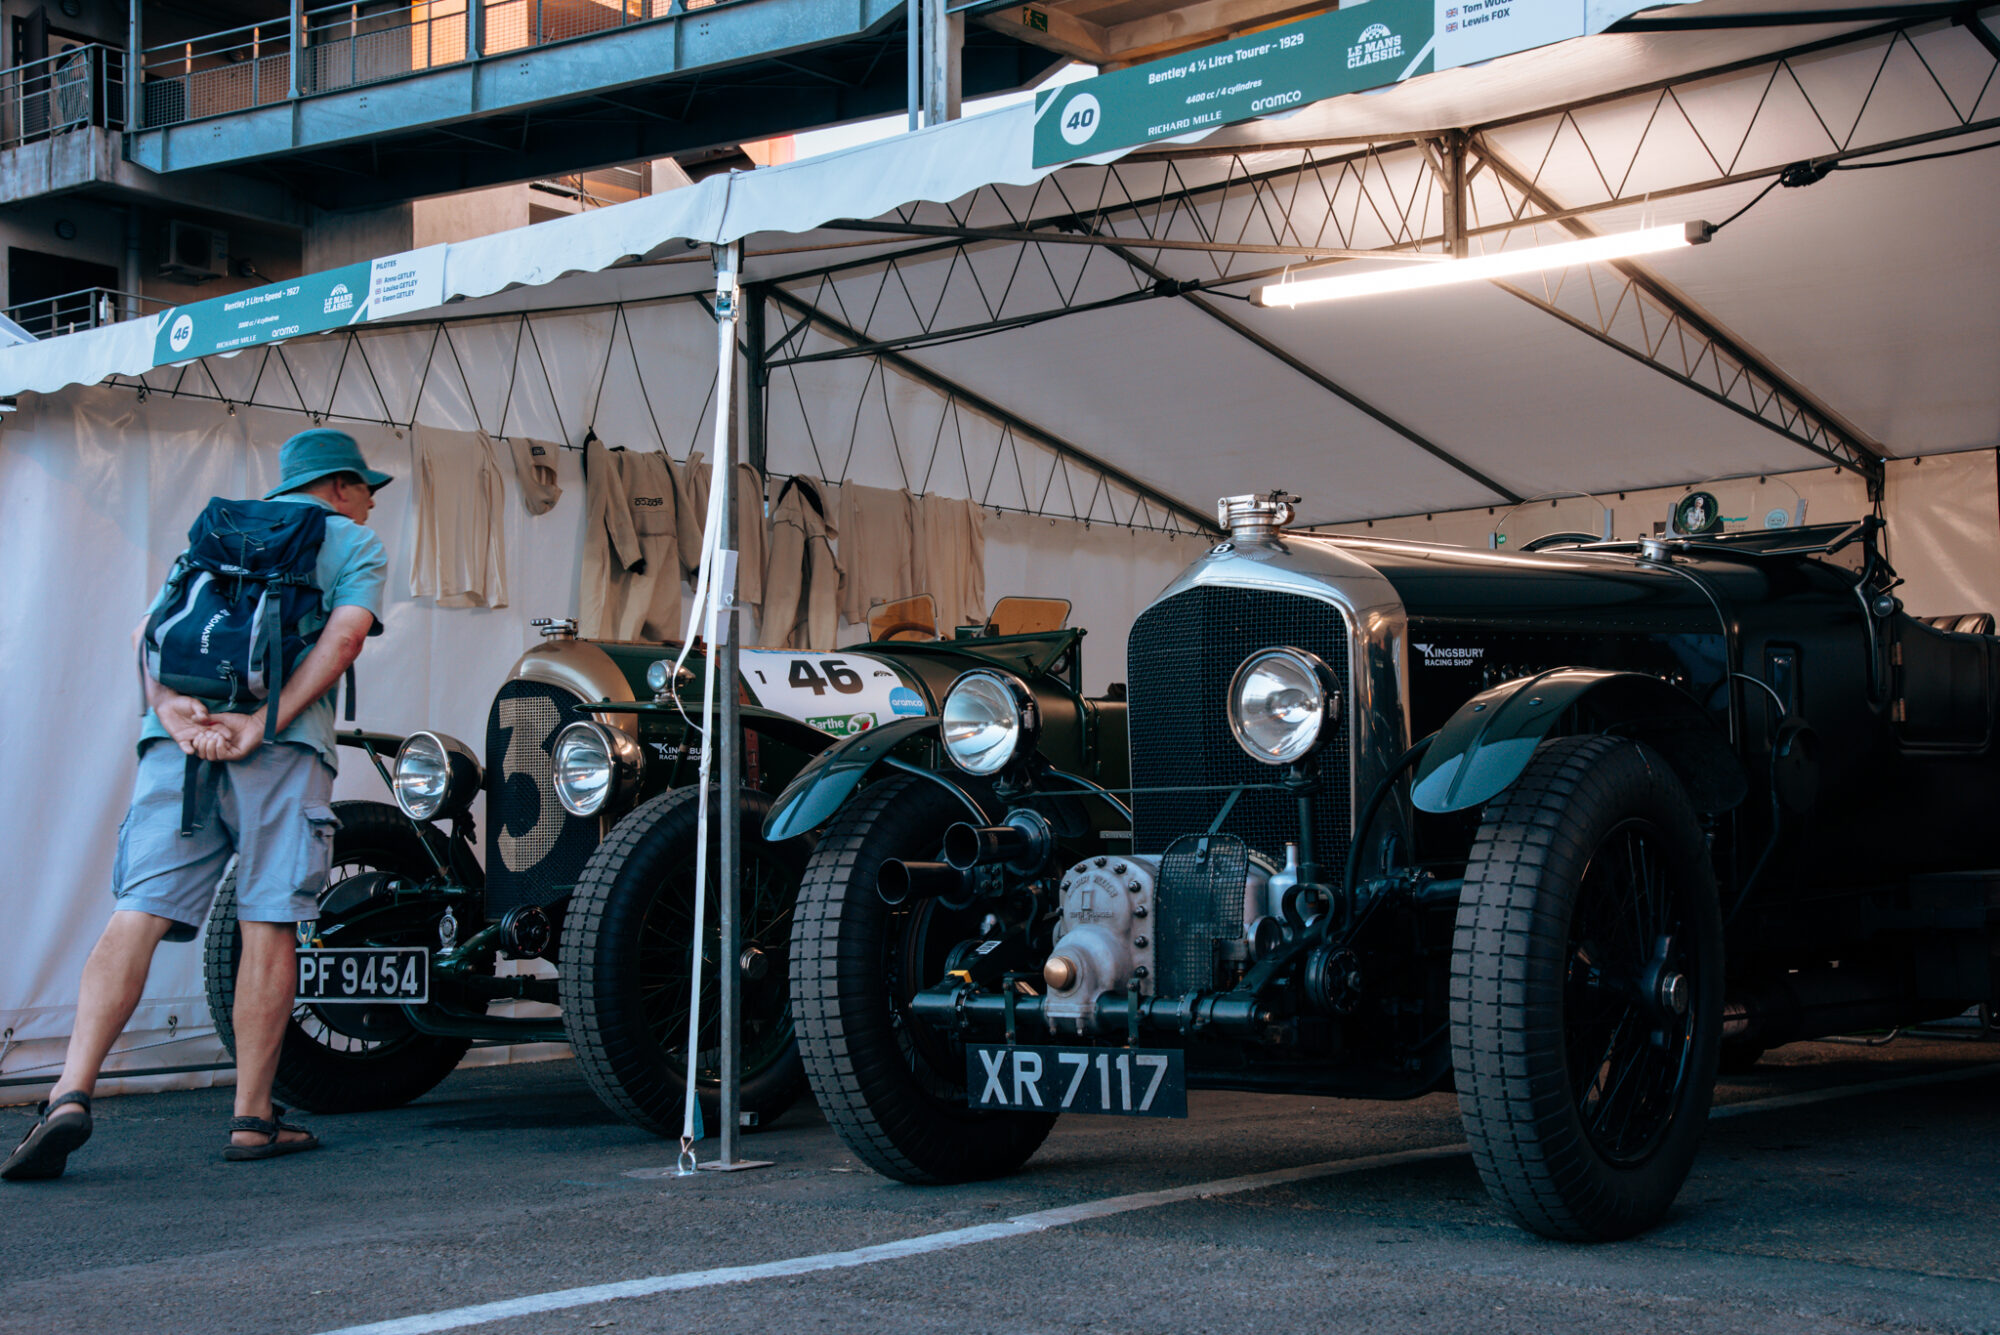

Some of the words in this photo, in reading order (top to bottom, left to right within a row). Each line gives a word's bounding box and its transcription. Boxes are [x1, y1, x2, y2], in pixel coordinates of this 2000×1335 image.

[1462, 3, 1482, 14] Tom
[1462, 14, 1490, 28] Lewis
[1492, 8, 1510, 21] FOX
[1347, 45, 1363, 58] LE
[1365, 34, 1401, 53] MANS
[1148, 66, 1187, 84] Bentley
[1189, 62, 1196, 73] 4
[1209, 53, 1233, 68] Litre
[1235, 43, 1271, 61] Tourer
[1279, 33, 1304, 49] 1929
[1347, 46, 1401, 69] CLASSIC
[1185, 93, 1206, 104] 4400
[1221, 87, 1227, 96] 4
[1227, 79, 1262, 95] cylindres
[1251, 90, 1301, 112] aramco
[1066, 108, 1095, 130] 40
[1148, 119, 1190, 136] RICHARD
[1193, 110, 1222, 125] MILLE
[376, 260, 397, 270] PILOTES
[224, 301, 245, 311] Bentley
[250, 294, 264, 305] Litre
[264, 290, 282, 302] Speed
[286, 286, 300, 296] 1927
[324, 302, 353, 314] CLASSIC
[325, 298, 333, 306] LE
[334, 293, 353, 304] MANS
[174, 326, 189, 340] 46
[216, 339, 239, 349] RICHARD
[240, 335, 256, 344] MILLE
[272, 325, 299, 337] aramco
[200, 614, 223, 654] SURVIVOR
[1424, 644, 1484, 658] KINGSBURY
[788, 660, 864, 695] 46
[809, 718, 844, 730] Sarthe
[498, 696, 566, 872] 3
[300, 957, 335, 995] PF
[342, 956, 418, 995] 9454
[978, 1050, 1044, 1106] XR
[1058, 1053, 1168, 1111] 7117
